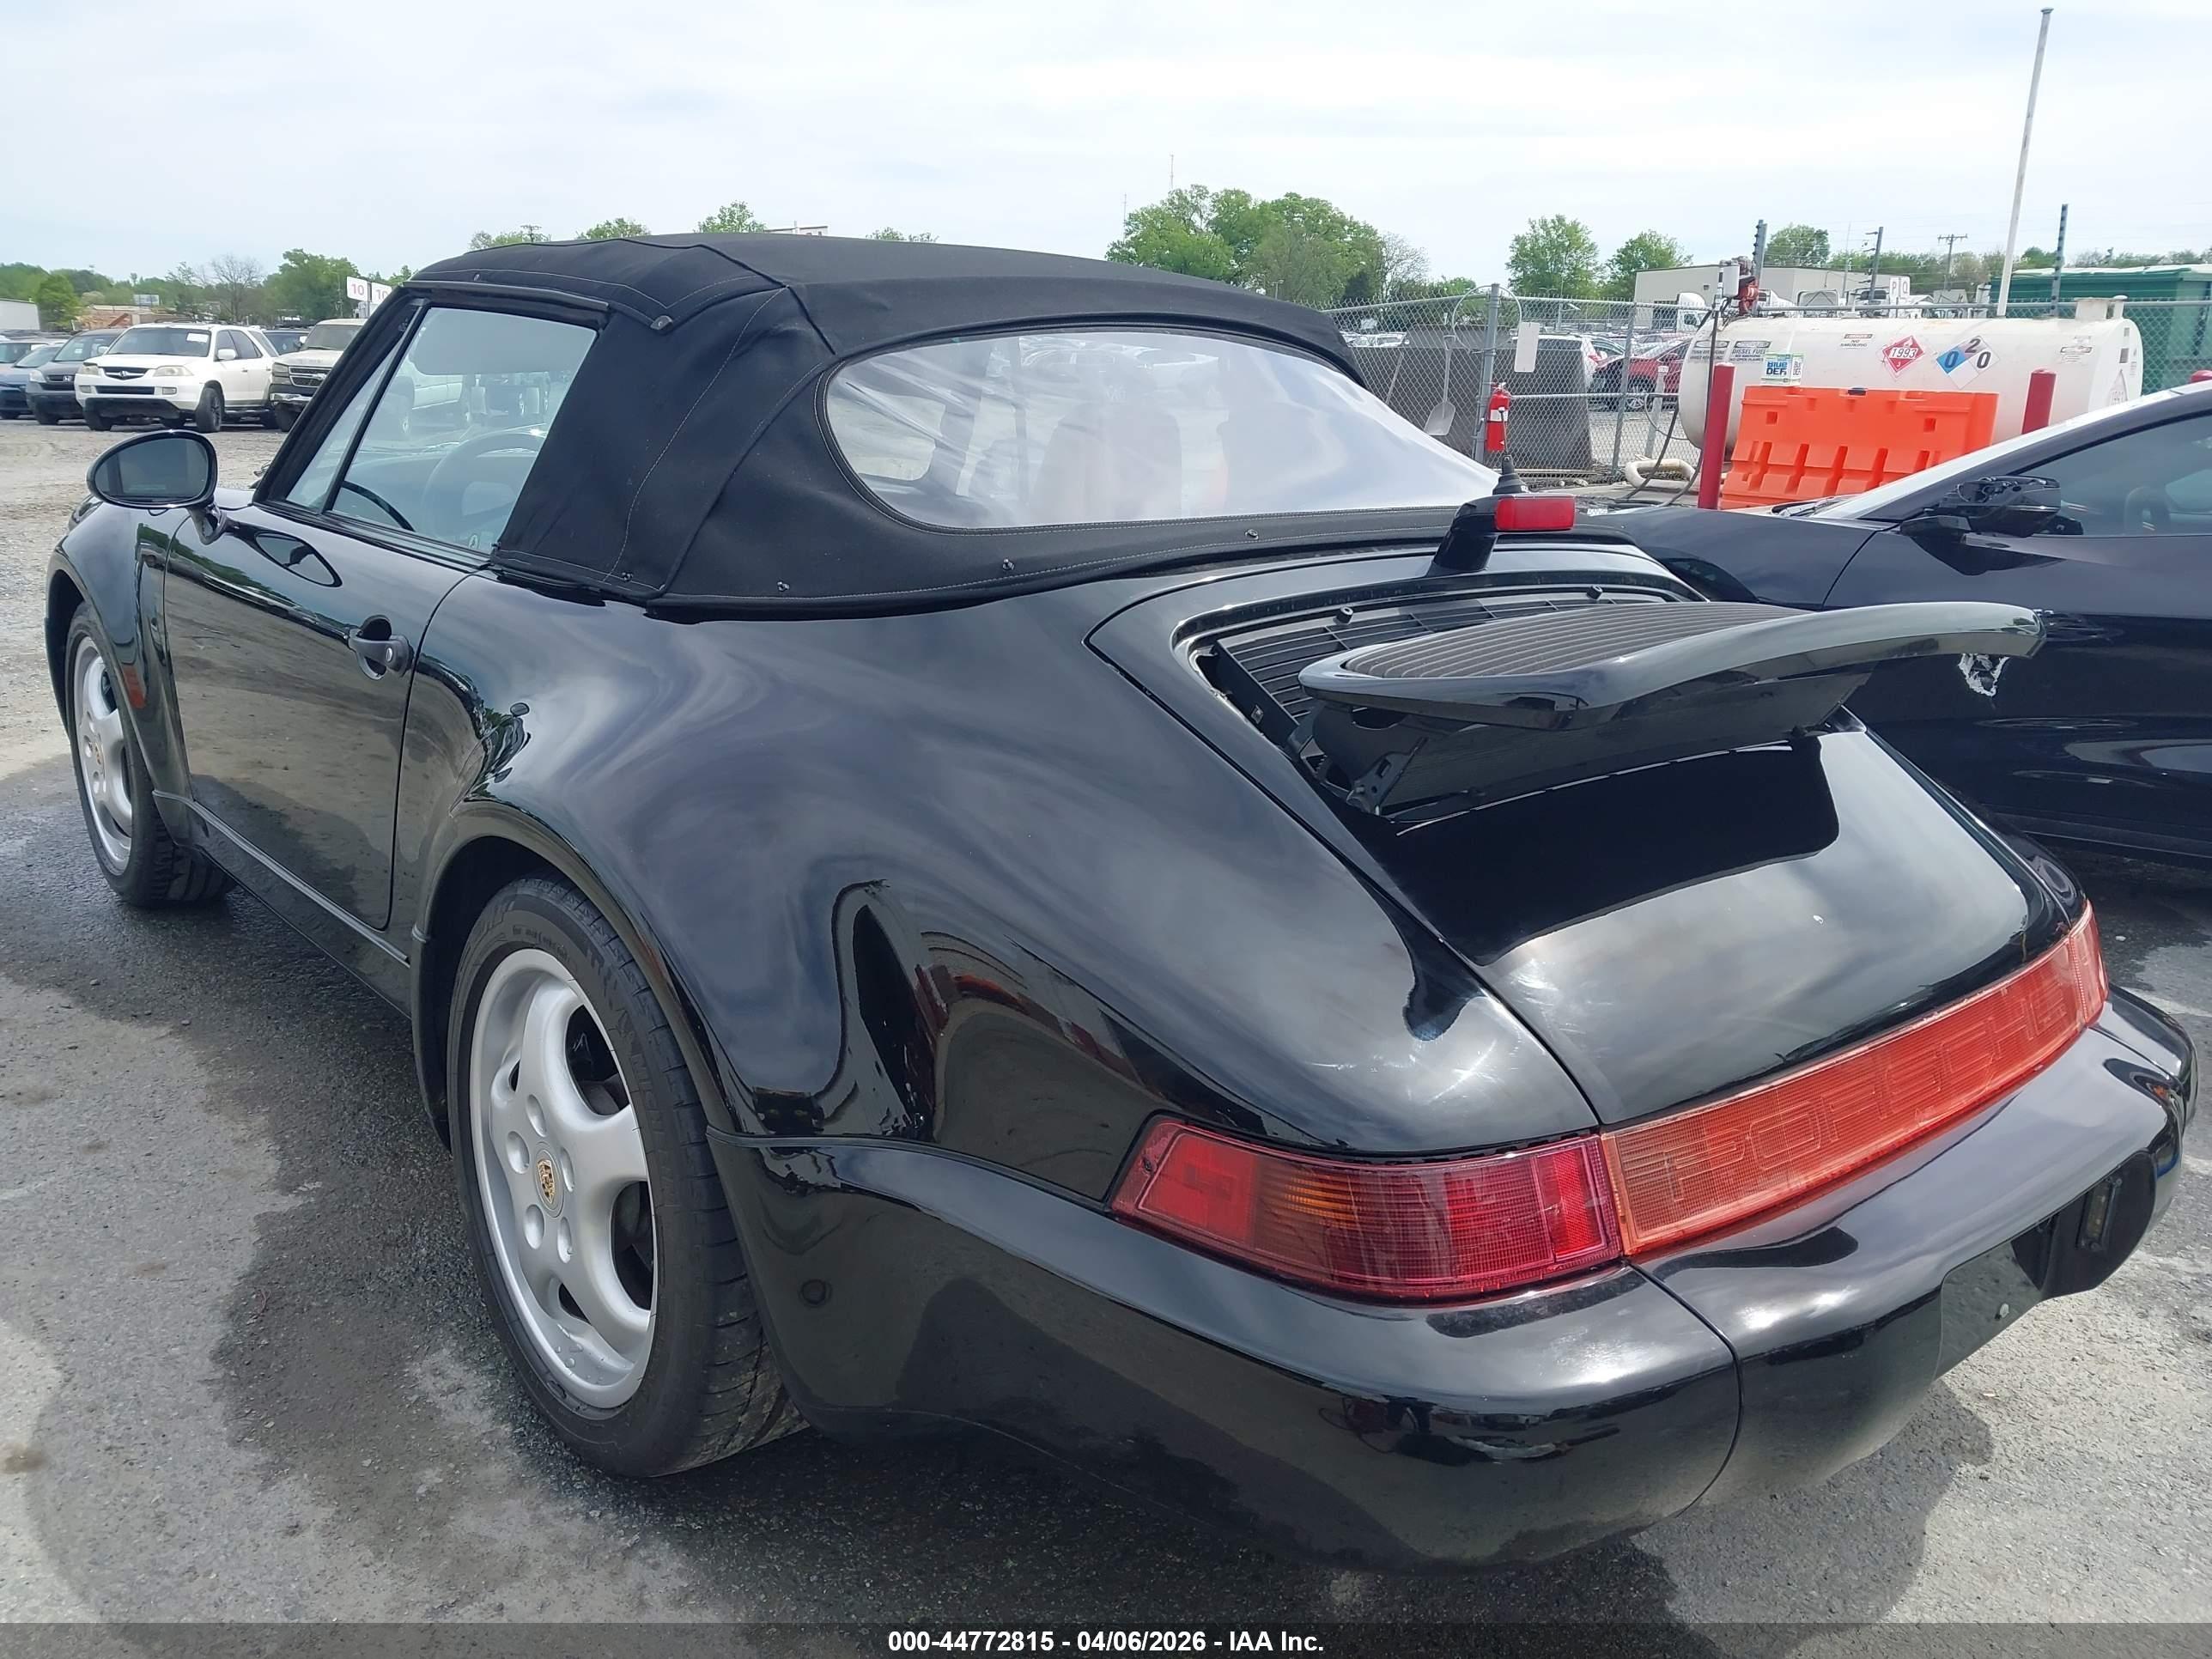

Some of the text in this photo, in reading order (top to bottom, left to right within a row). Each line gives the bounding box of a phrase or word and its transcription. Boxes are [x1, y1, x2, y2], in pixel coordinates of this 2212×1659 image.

[350, 283, 365, 296] 10
[1891, 347, 1917, 359] 1993
[1965, 337, 1982, 354] 2
[1944, 350, 1991, 369] 0 0
[1663, 974, 2067, 1202] PORSCHE
